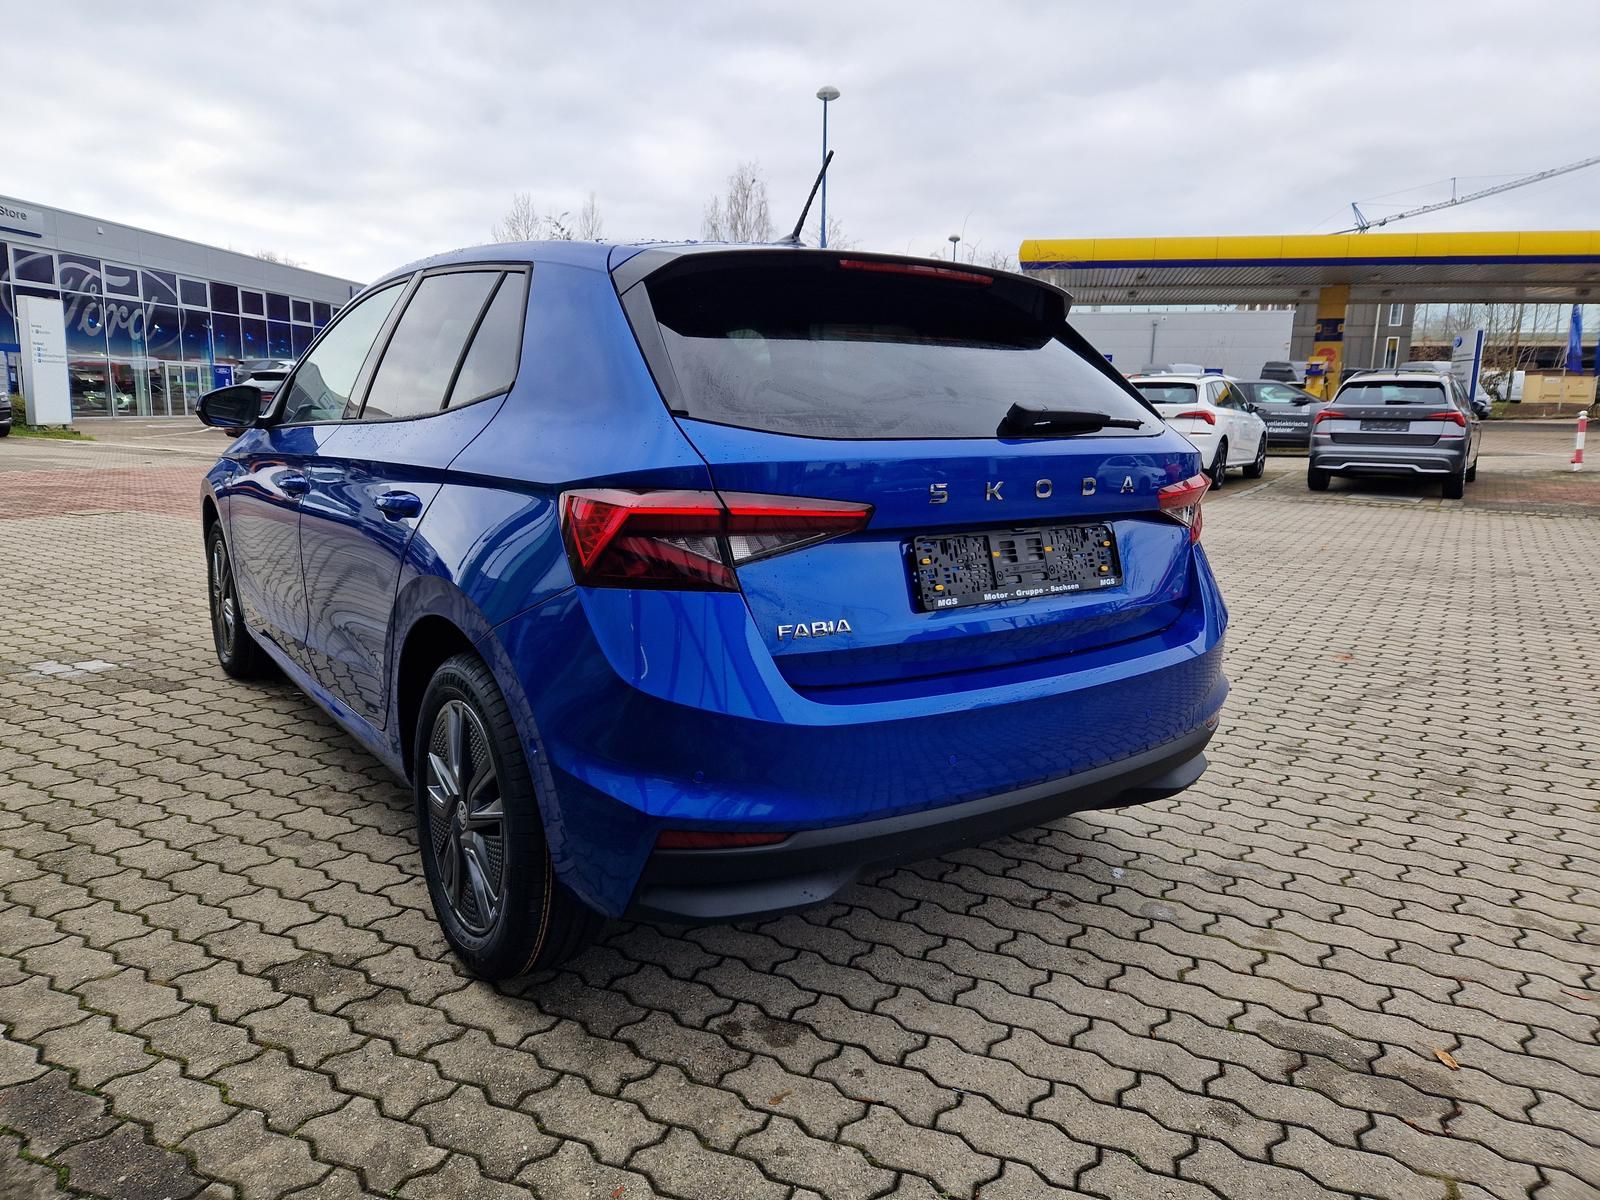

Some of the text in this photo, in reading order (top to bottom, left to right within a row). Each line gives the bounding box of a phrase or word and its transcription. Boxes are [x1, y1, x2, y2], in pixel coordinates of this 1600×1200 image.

[0, 205, 27, 220] Store
[57, 261, 159, 342] Ford
[937, 597, 958, 607] MGS
[984, 592, 1008, 601] Motor
[1016, 587, 1044, 597] Gruppe
[1050, 582, 1080, 592] Sachsen
[1100, 577, 1116, 586] MGS
[777, 619, 852, 640] FABIA
